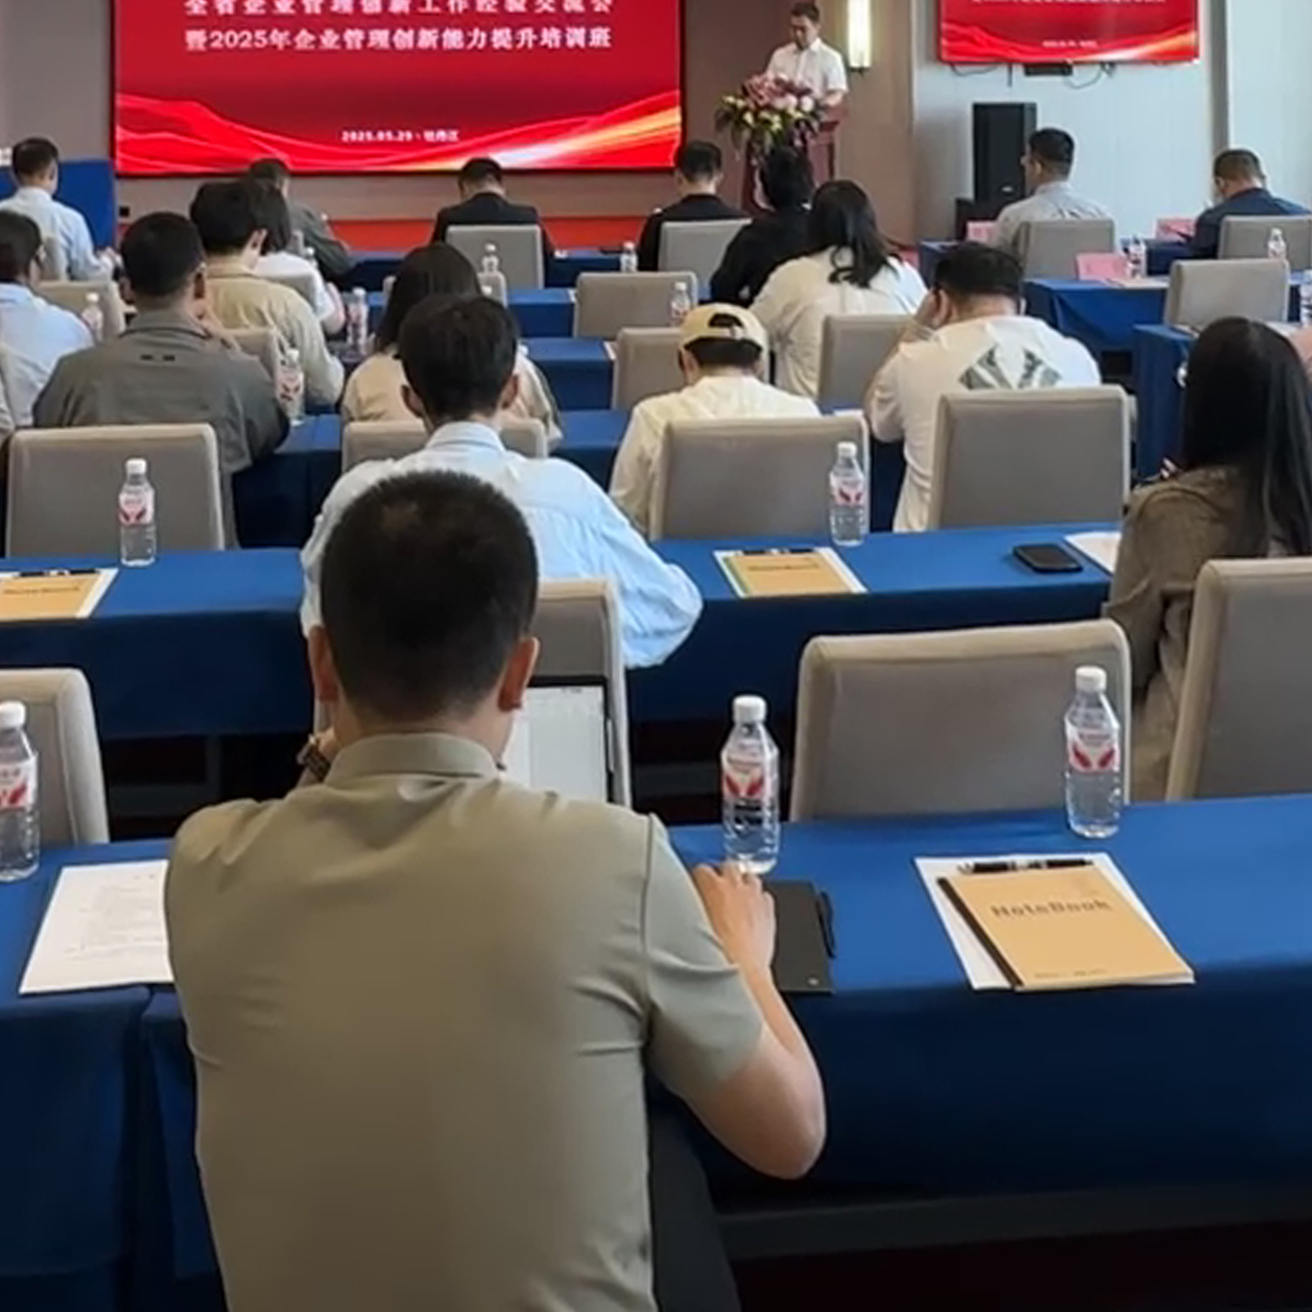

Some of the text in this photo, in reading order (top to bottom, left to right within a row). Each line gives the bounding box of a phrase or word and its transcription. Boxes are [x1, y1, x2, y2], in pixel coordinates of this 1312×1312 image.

[184, 26, 612, 51] 暨2025年企业管理创新能力提升培训班
[990, 898, 1112, 918] NoteBook
